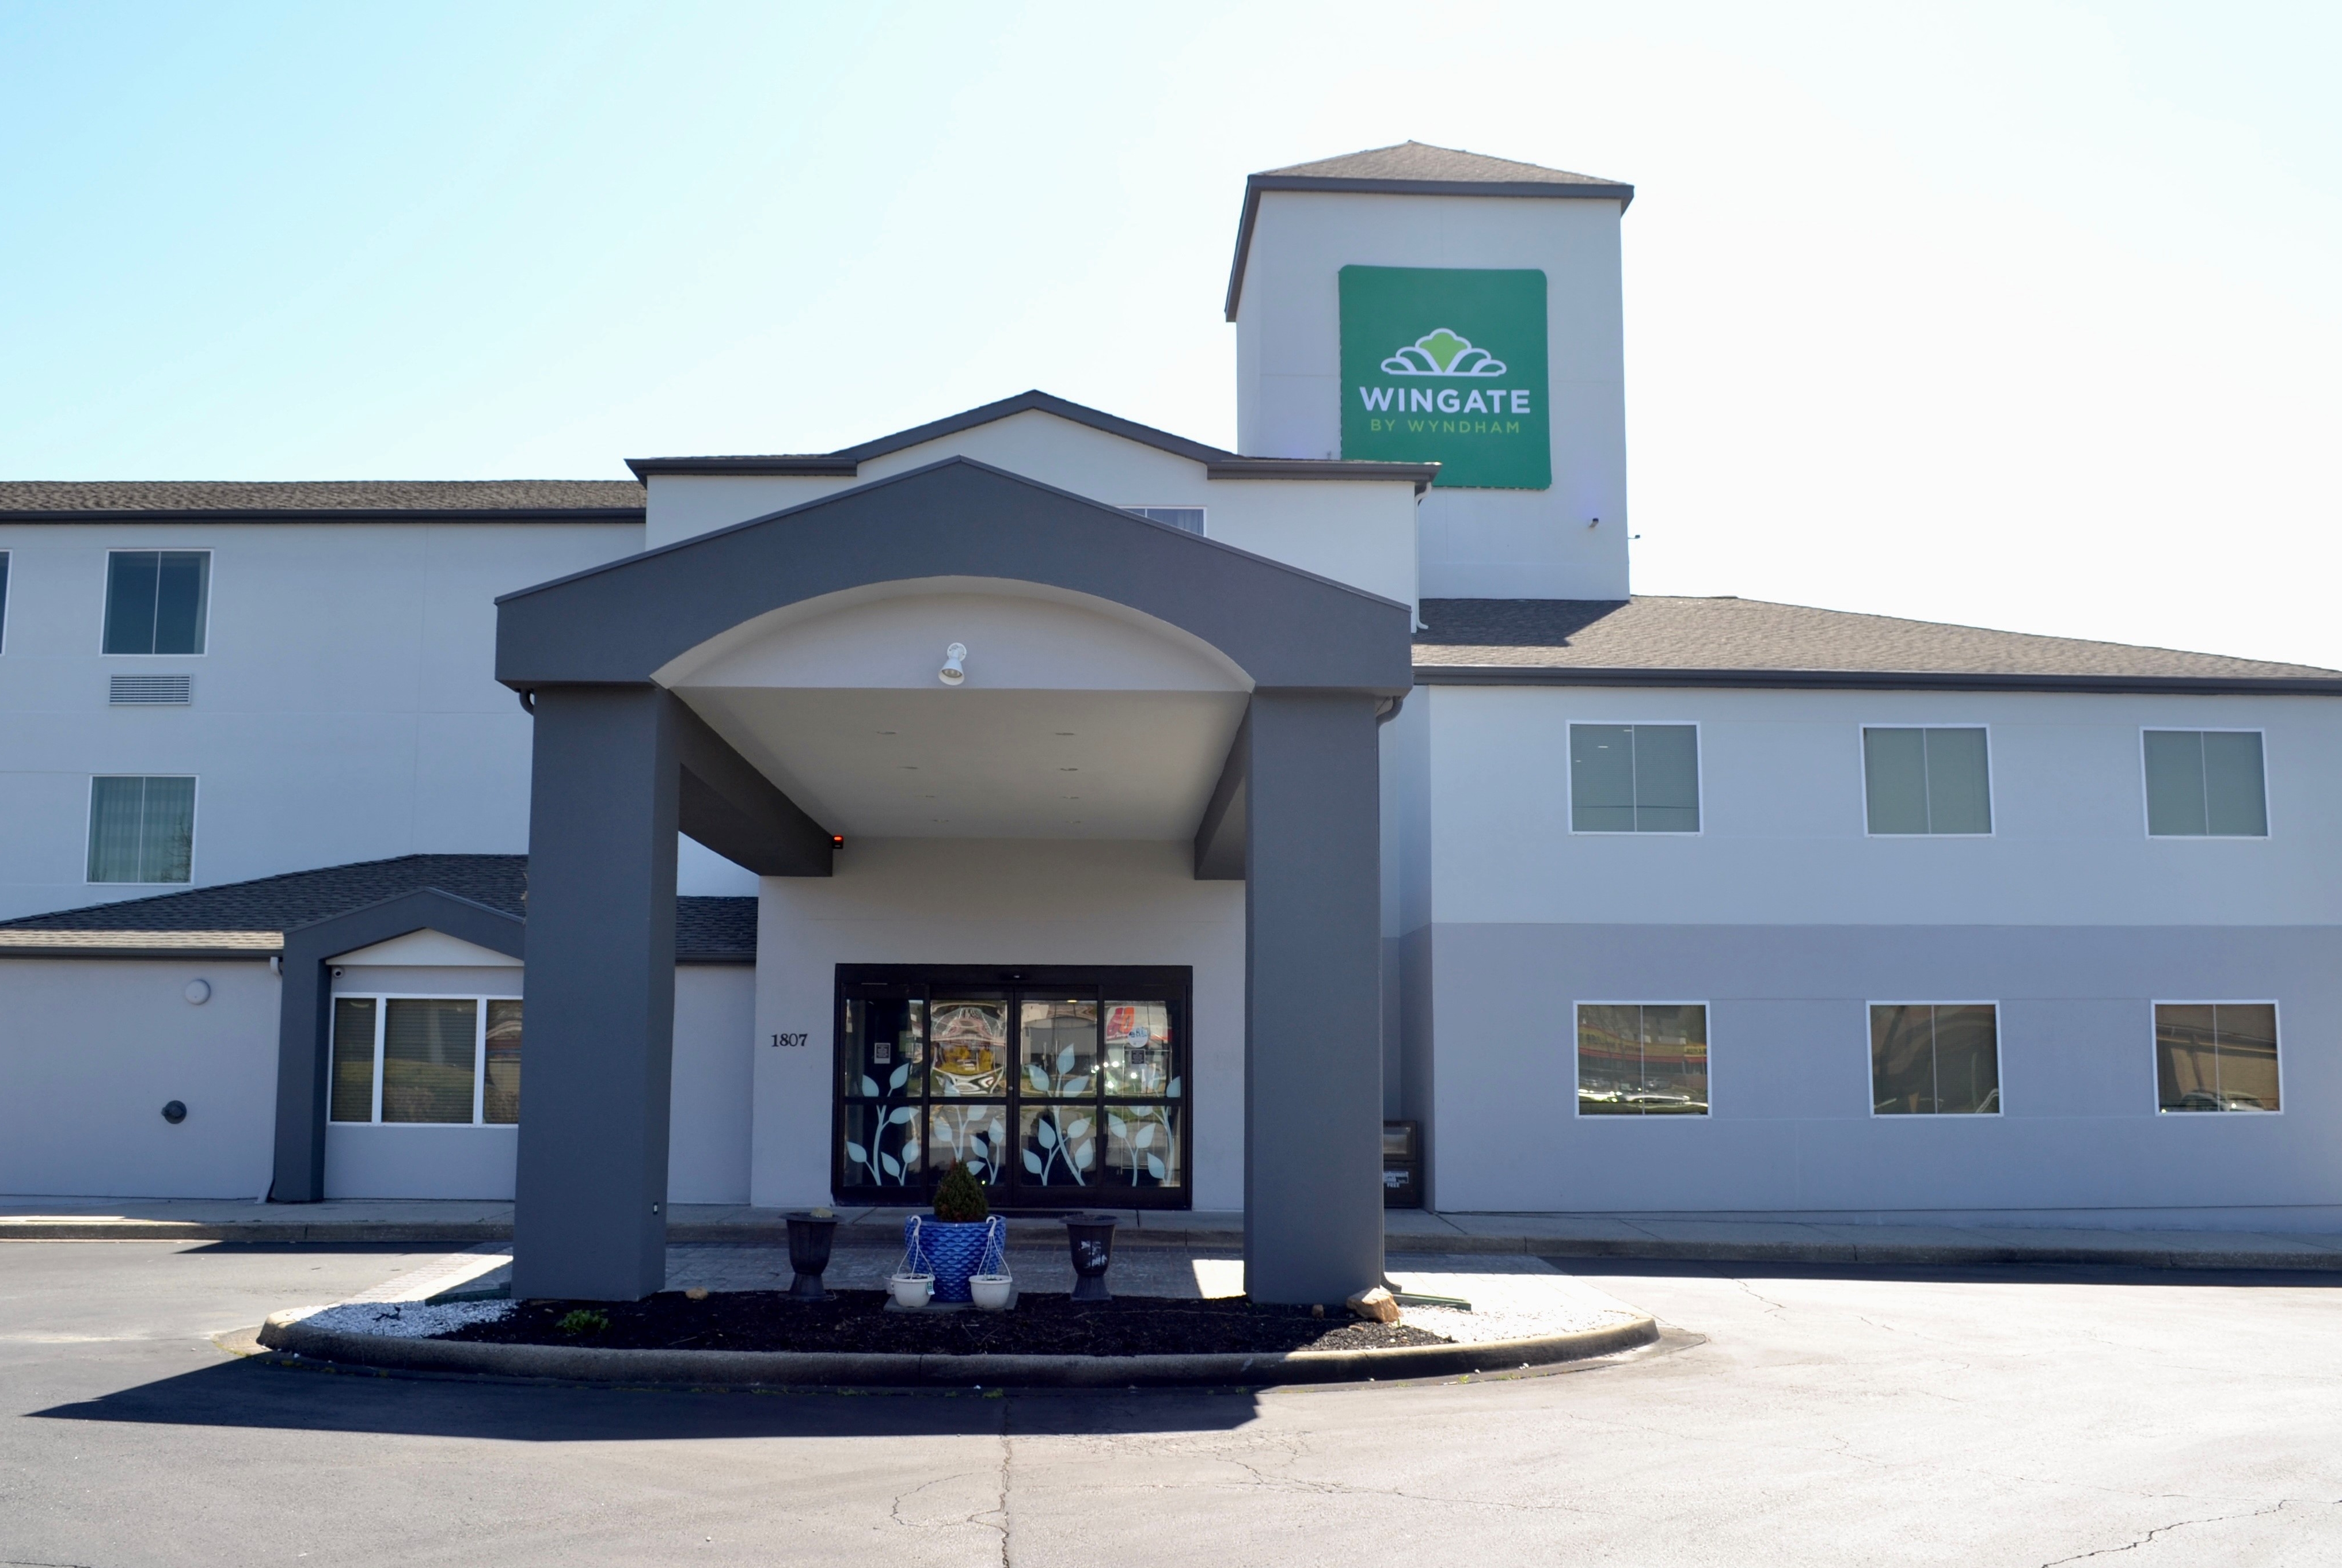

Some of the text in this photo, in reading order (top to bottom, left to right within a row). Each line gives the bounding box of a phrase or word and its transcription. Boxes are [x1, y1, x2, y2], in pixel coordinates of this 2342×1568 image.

[1359, 386, 1530, 413] WINGATE
[1370, 418, 1519, 433] BY WYNDHAM
[771, 1033, 808, 1047] 1807
